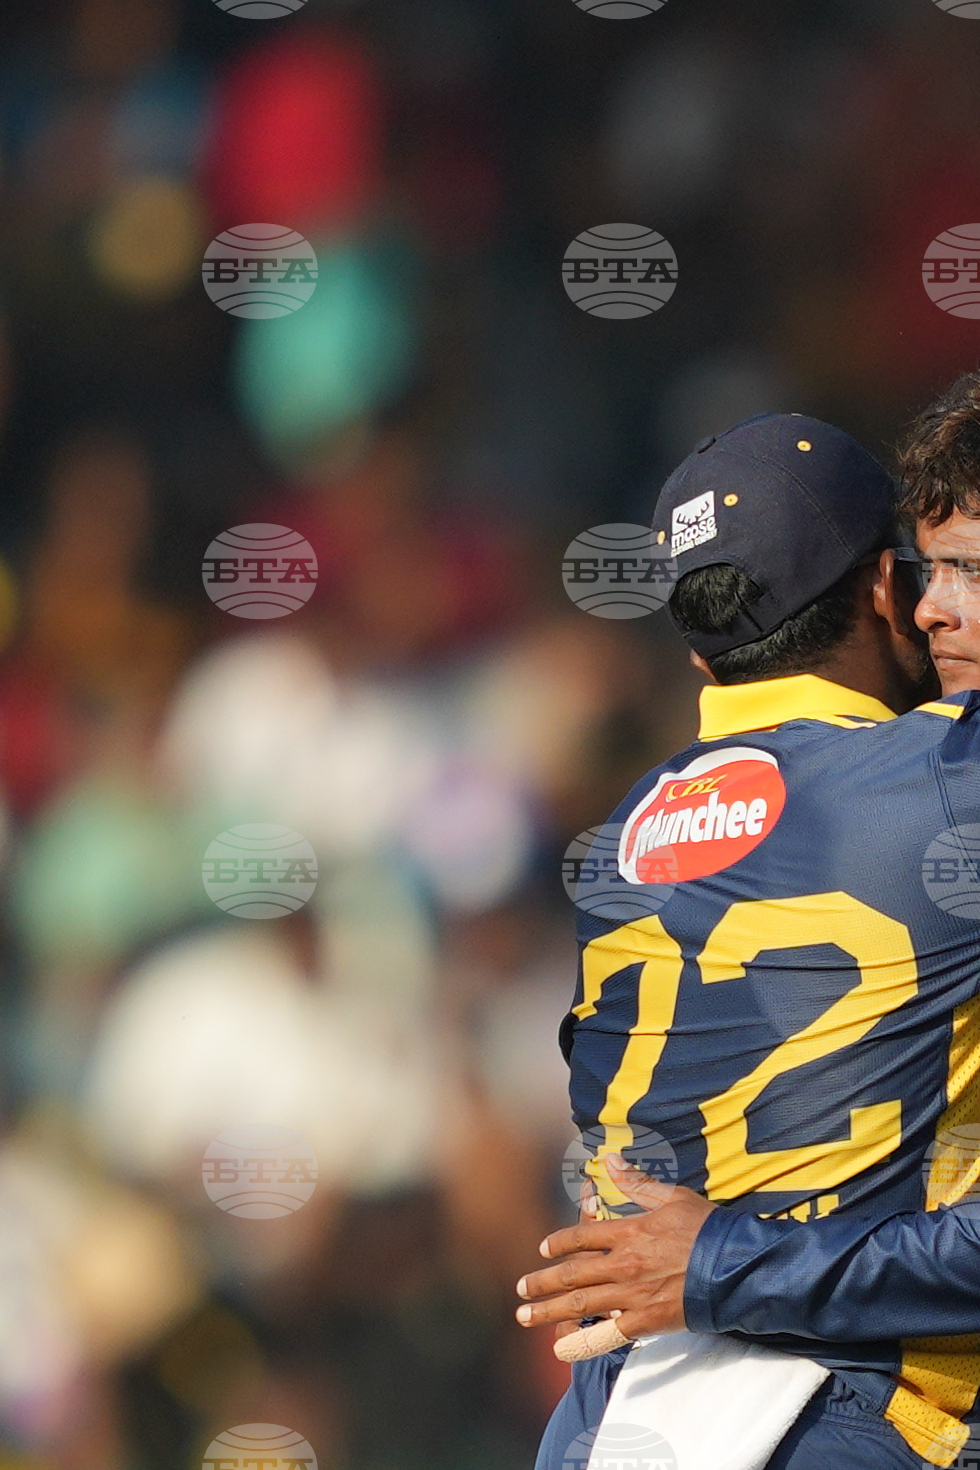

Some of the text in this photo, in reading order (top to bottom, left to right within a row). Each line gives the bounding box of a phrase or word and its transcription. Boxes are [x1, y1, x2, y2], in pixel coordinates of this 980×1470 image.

[671, 516, 716, 549] moose
[636, 790, 768, 859] Munchee
[572, 890, 919, 1207] 72
